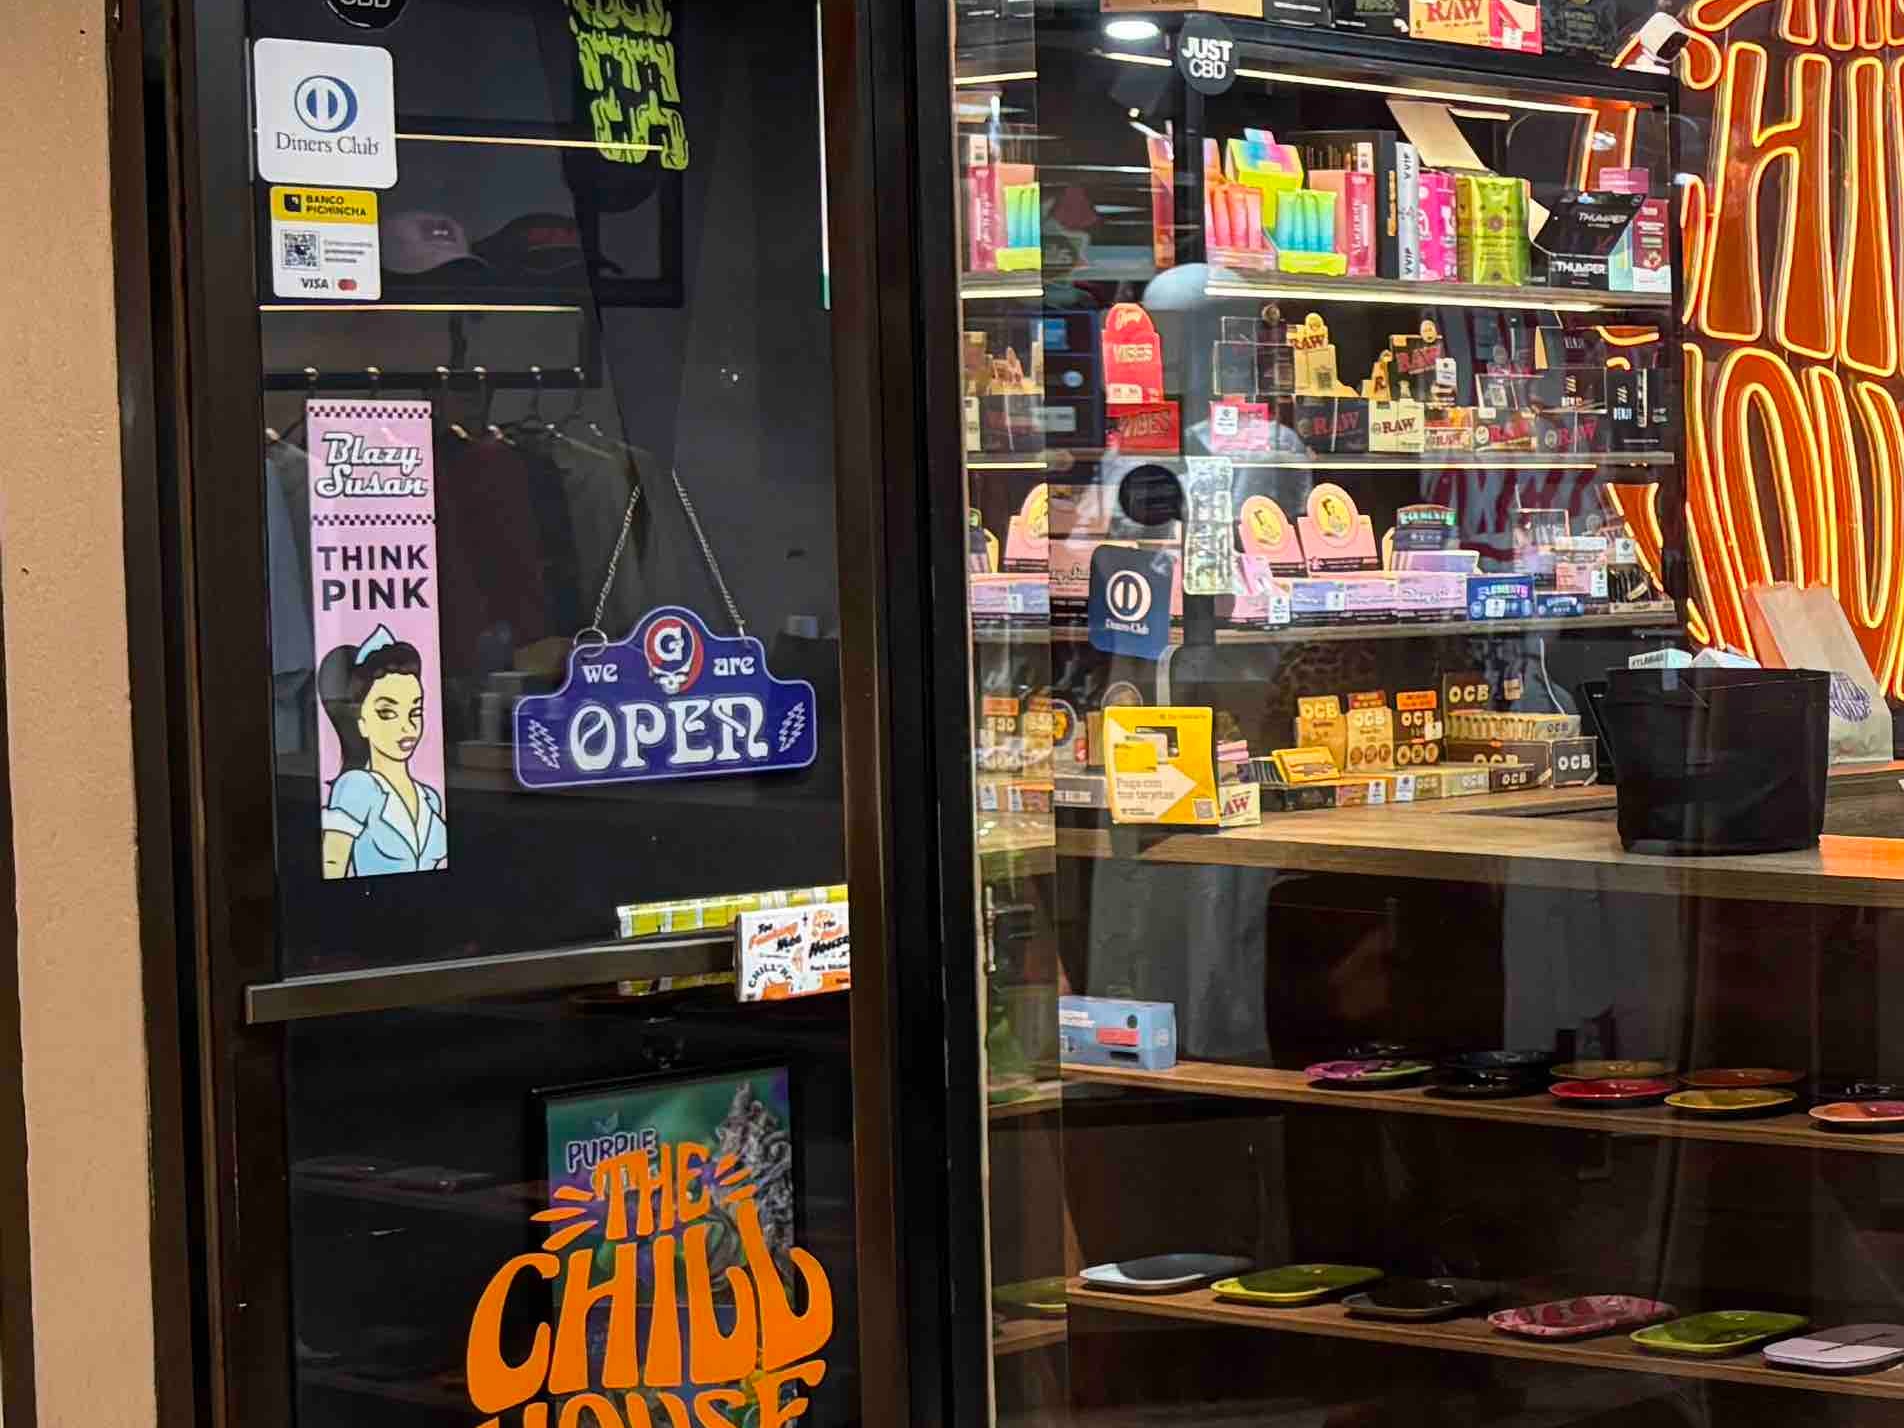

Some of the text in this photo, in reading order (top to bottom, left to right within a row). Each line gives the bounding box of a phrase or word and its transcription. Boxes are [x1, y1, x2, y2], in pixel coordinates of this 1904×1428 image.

[1181, 37, 1233, 61] JUST
[1189, 58, 1226, 79] CBD
[276, 131, 380, 156] Diners Club
[305, 194, 344, 206] BANCO
[306, 204, 367, 217] PICHINCHA
[1553, 259, 1607, 274] THUMPER
[301, 277, 329, 290] VISA
[1383, 417, 1417, 434] RAW
[324, 432, 424, 475] Blazy
[315, 464, 428, 499] Susan
[317, 544, 429, 572] THINK
[321, 578, 429, 612] PINK
[656, 627, 685, 660] G
[712, 653, 755, 678] are
[1448, 684, 1489, 703] OCB
[1302, 700, 1339, 720] OCB
[1401, 710, 1435, 727] OCB
[569, 695, 769, 773] OPEN
[1558, 754, 1592, 771] OCB
[567, 1128, 657, 1173] PURPLE
[594, 1141, 712, 1240] THE
[467, 1195, 834, 1414] CHILL
